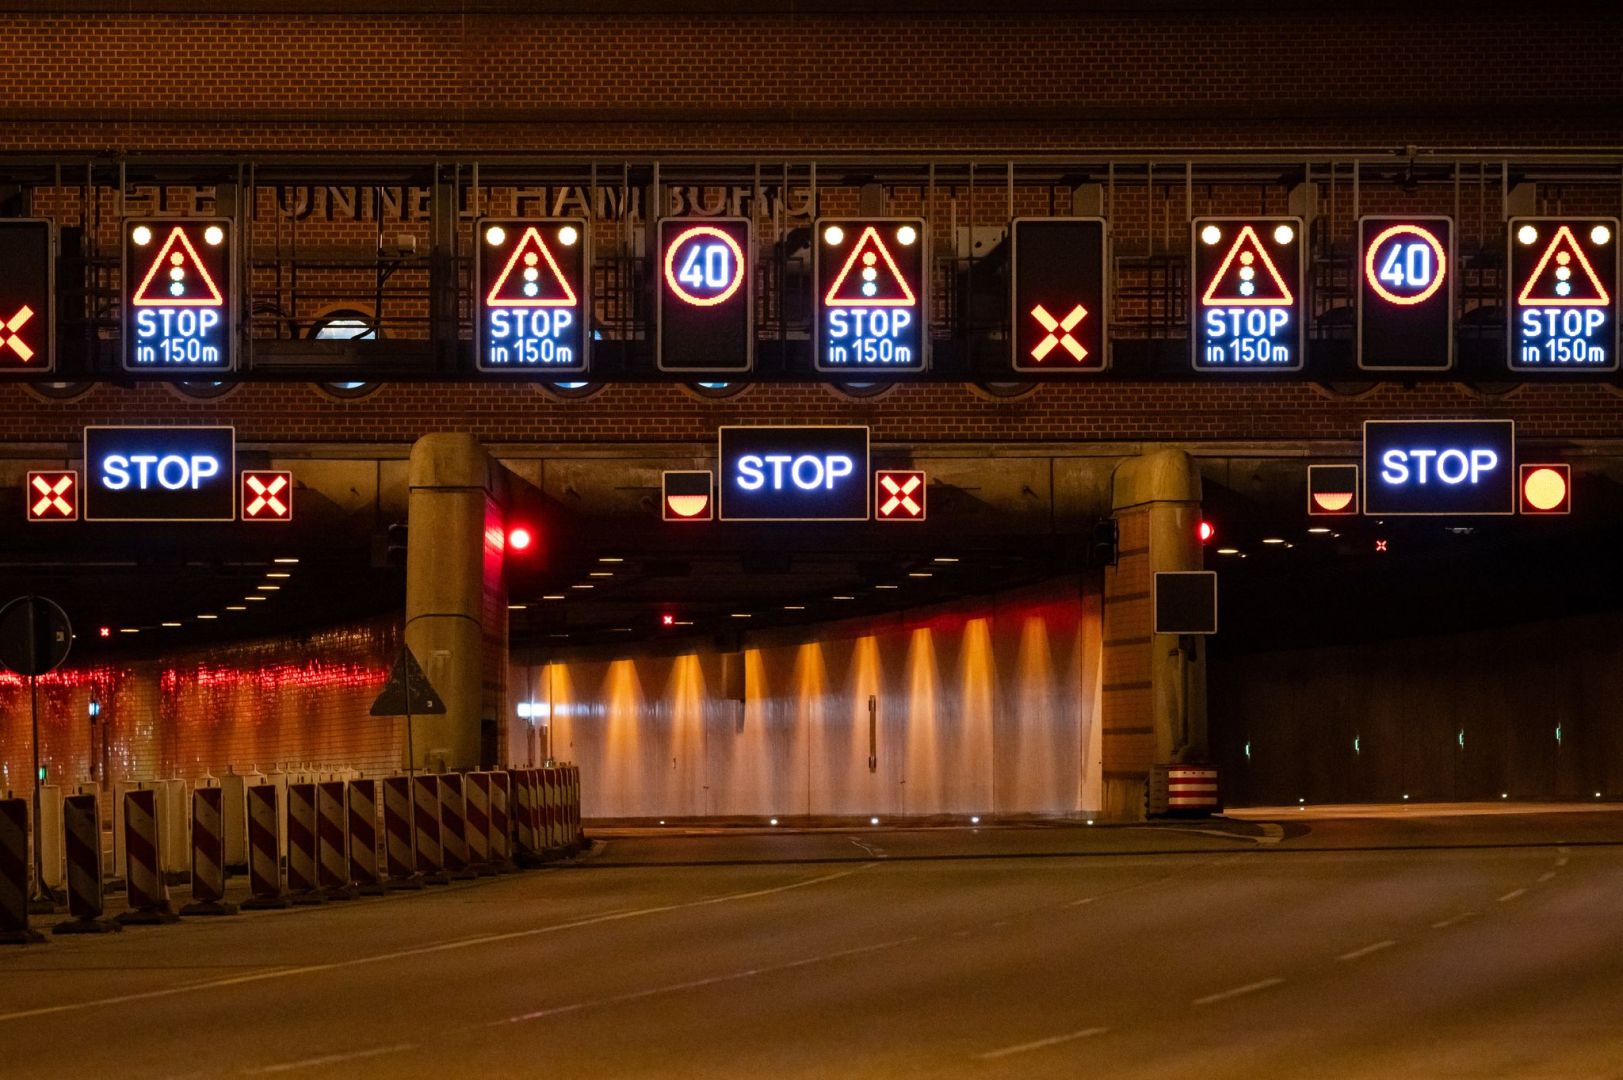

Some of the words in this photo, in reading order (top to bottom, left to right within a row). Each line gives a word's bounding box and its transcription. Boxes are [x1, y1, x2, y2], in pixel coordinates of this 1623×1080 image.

[680, 244, 729, 288] 40
[1380, 244, 1430, 287] 40
[137, 309, 219, 337] STOP
[491, 309, 572, 338] STOP
[829, 309, 911, 337] STOP
[1206, 309, 1288, 337] STOP
[1523, 309, 1605, 336] STOP
[138, 340, 154, 361] in
[491, 340, 508, 362] in
[829, 340, 847, 362] in
[1207, 340, 1224, 361] in
[1523, 340, 1540, 361] in
[103, 455, 219, 489] STOP
[737, 455, 853, 490] STOP
[1382, 449, 1498, 484] STOP
